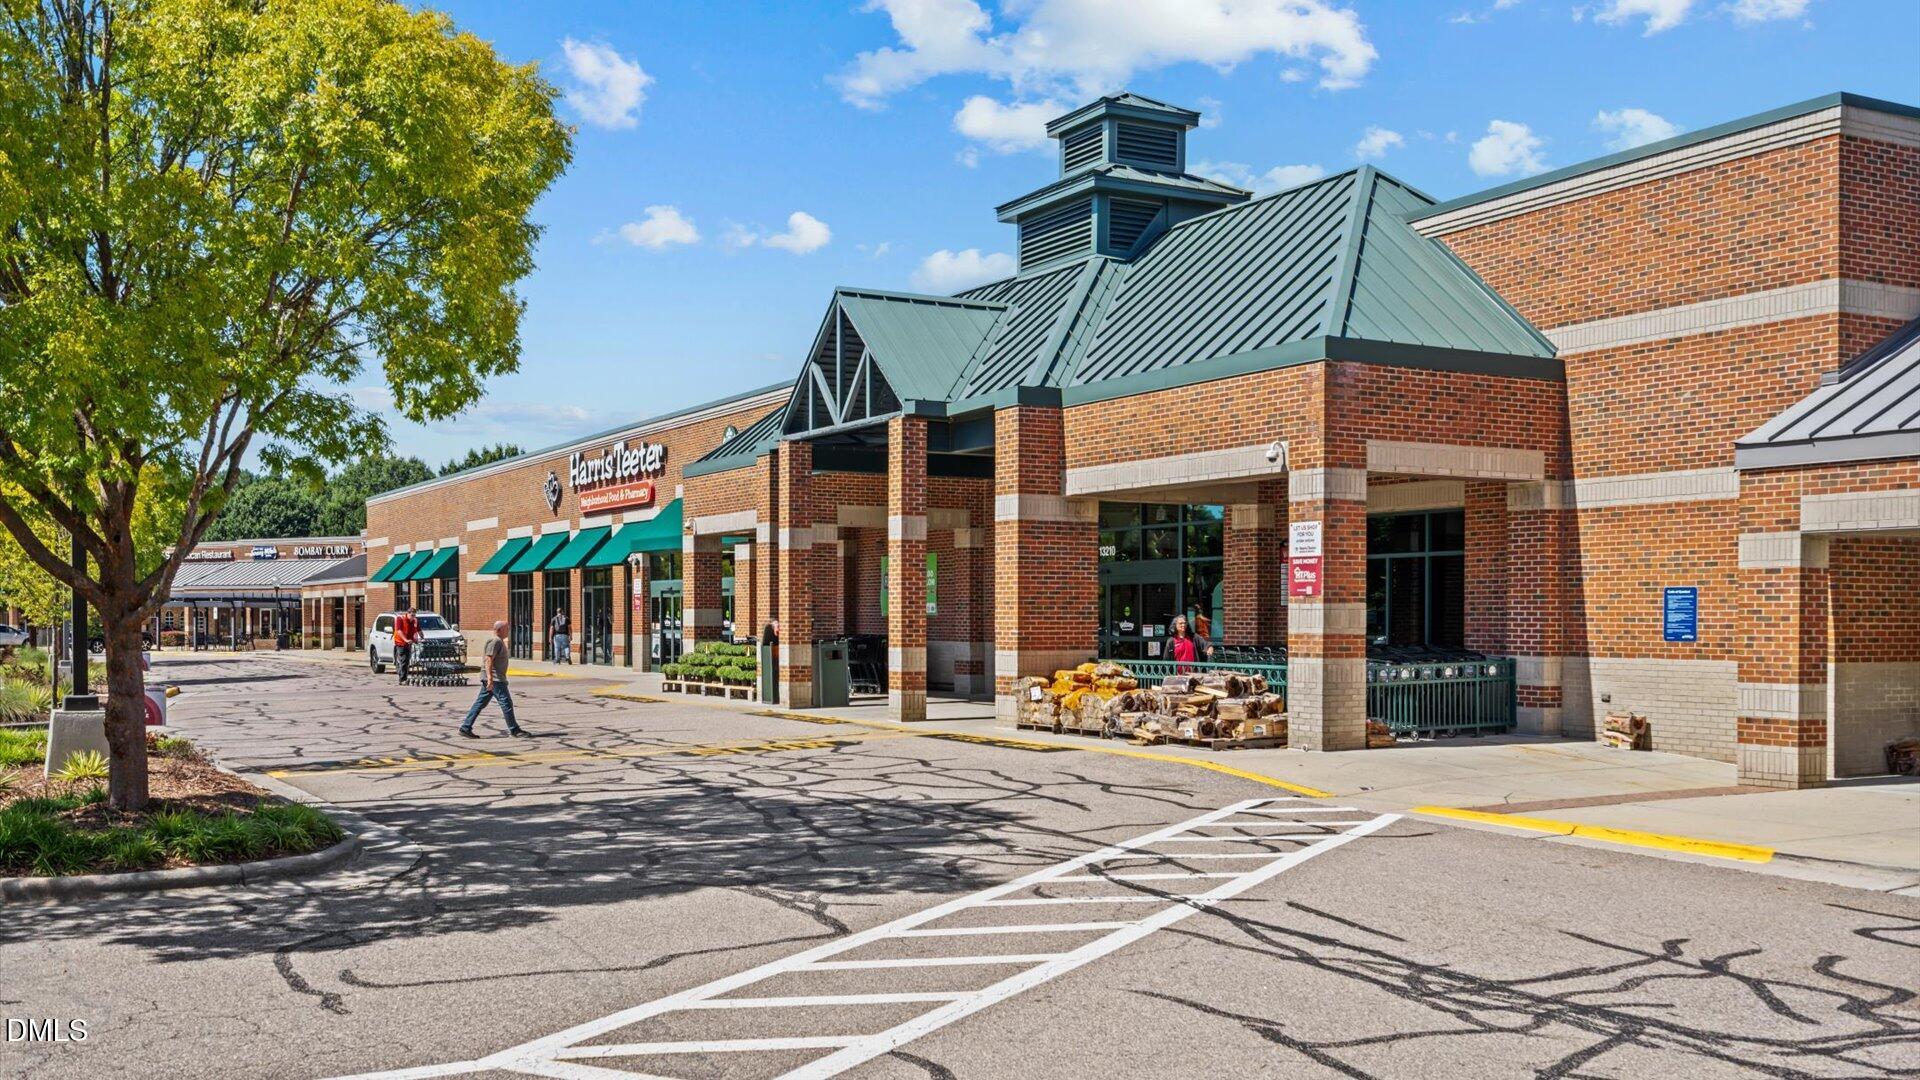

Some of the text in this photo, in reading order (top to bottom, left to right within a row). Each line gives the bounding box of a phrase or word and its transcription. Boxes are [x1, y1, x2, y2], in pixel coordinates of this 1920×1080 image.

[569, 441, 662, 487] Harris Teeter
[608, 490, 620, 503] Food
[202, 550, 232, 559] Restaurant
[294, 545, 349, 556] BOMBAY CURRY
[1099, 545, 1116, 556] 13210
